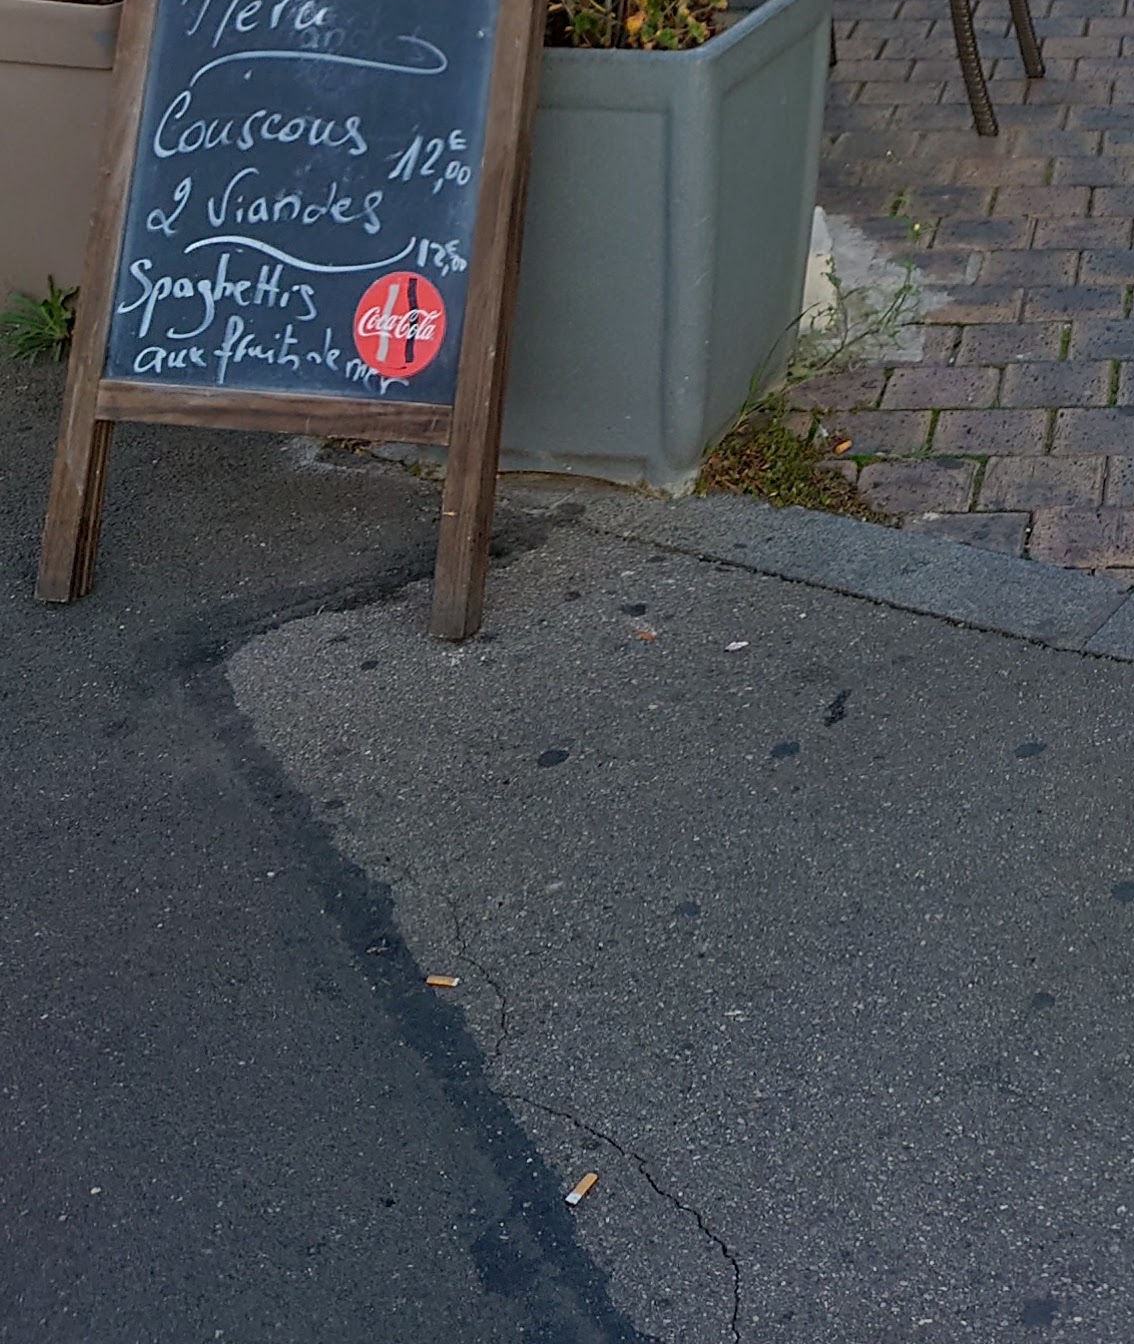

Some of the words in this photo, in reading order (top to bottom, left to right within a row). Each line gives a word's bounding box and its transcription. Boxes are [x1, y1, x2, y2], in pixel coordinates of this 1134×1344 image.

[153, 89, 368, 158] Couscous
[207, 167, 383, 235] Viandes
[357, 306, 442, 341] Coca-Cola
